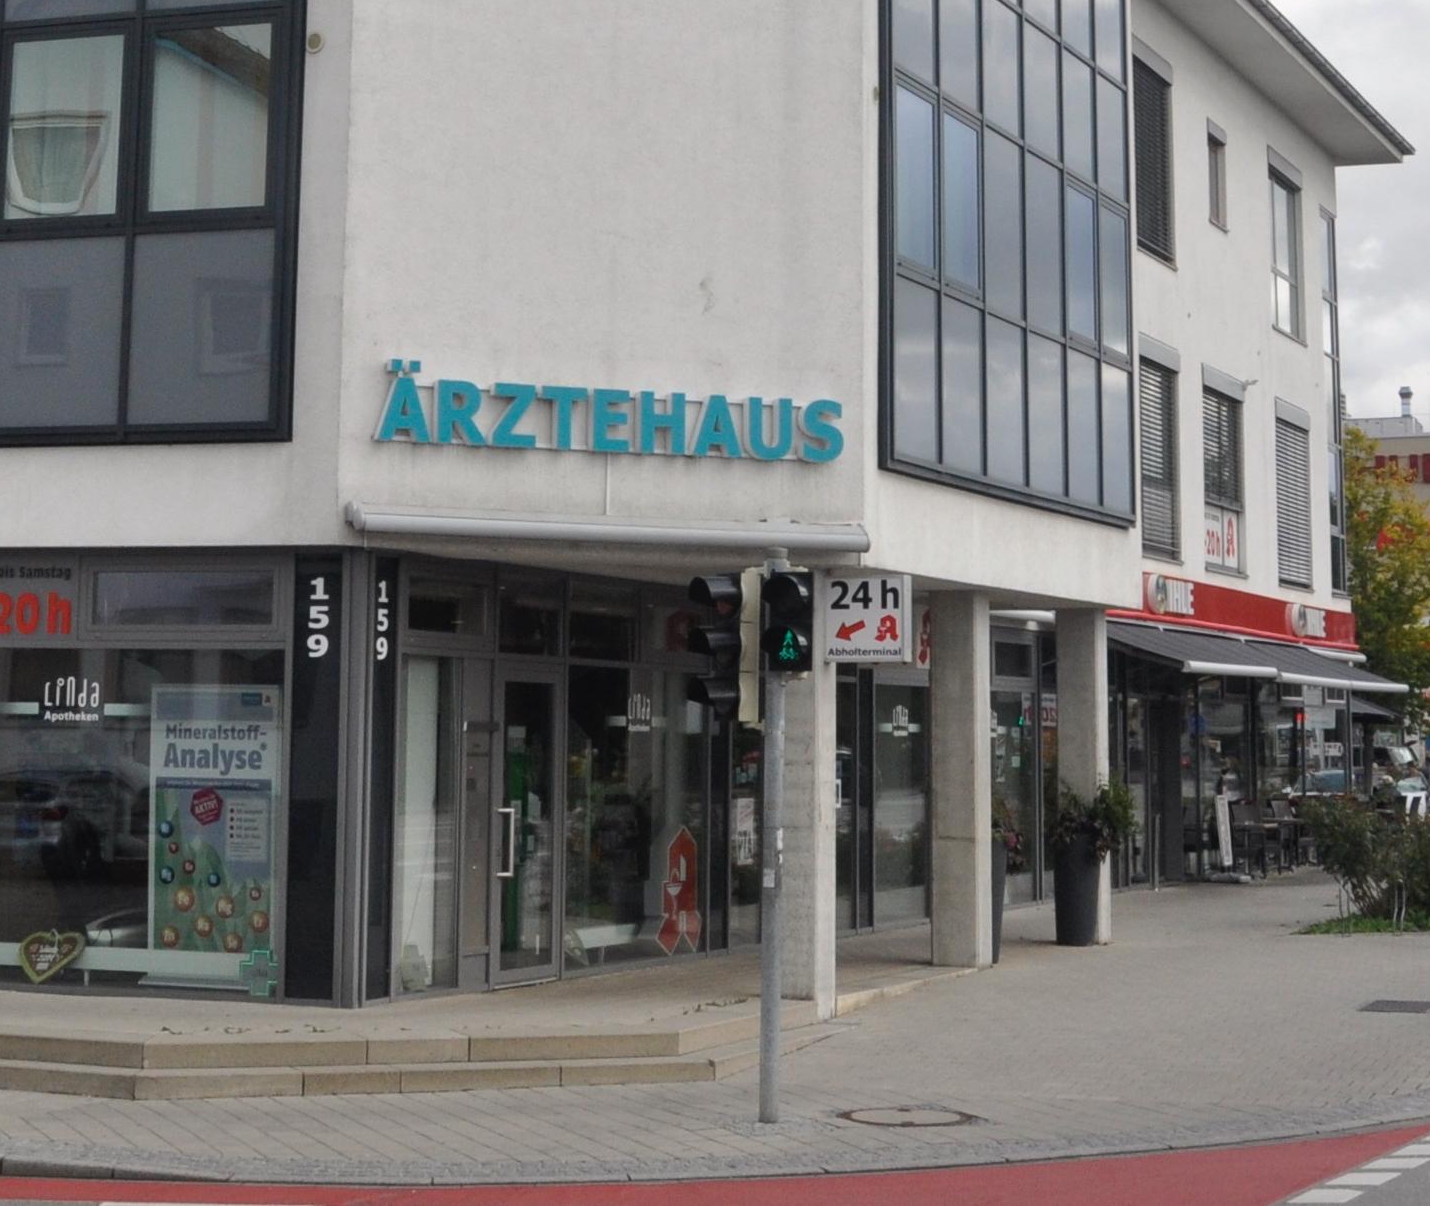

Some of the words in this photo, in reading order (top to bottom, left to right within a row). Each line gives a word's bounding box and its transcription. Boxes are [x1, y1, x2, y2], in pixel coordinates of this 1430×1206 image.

[374, 358, 845, 463] ÄRZTEHAUS
[18, 566, 72, 581] Samstag
[830, 579, 873, 610] 24
[880, 578, 900, 610] h
[307, 576, 330, 658] 159
[375, 579, 389, 661] 159
[827, 647, 902, 657] Abholterminal
[43, 710, 100, 723] Apotheken
[164, 722, 267, 741] Mineralstoff-
